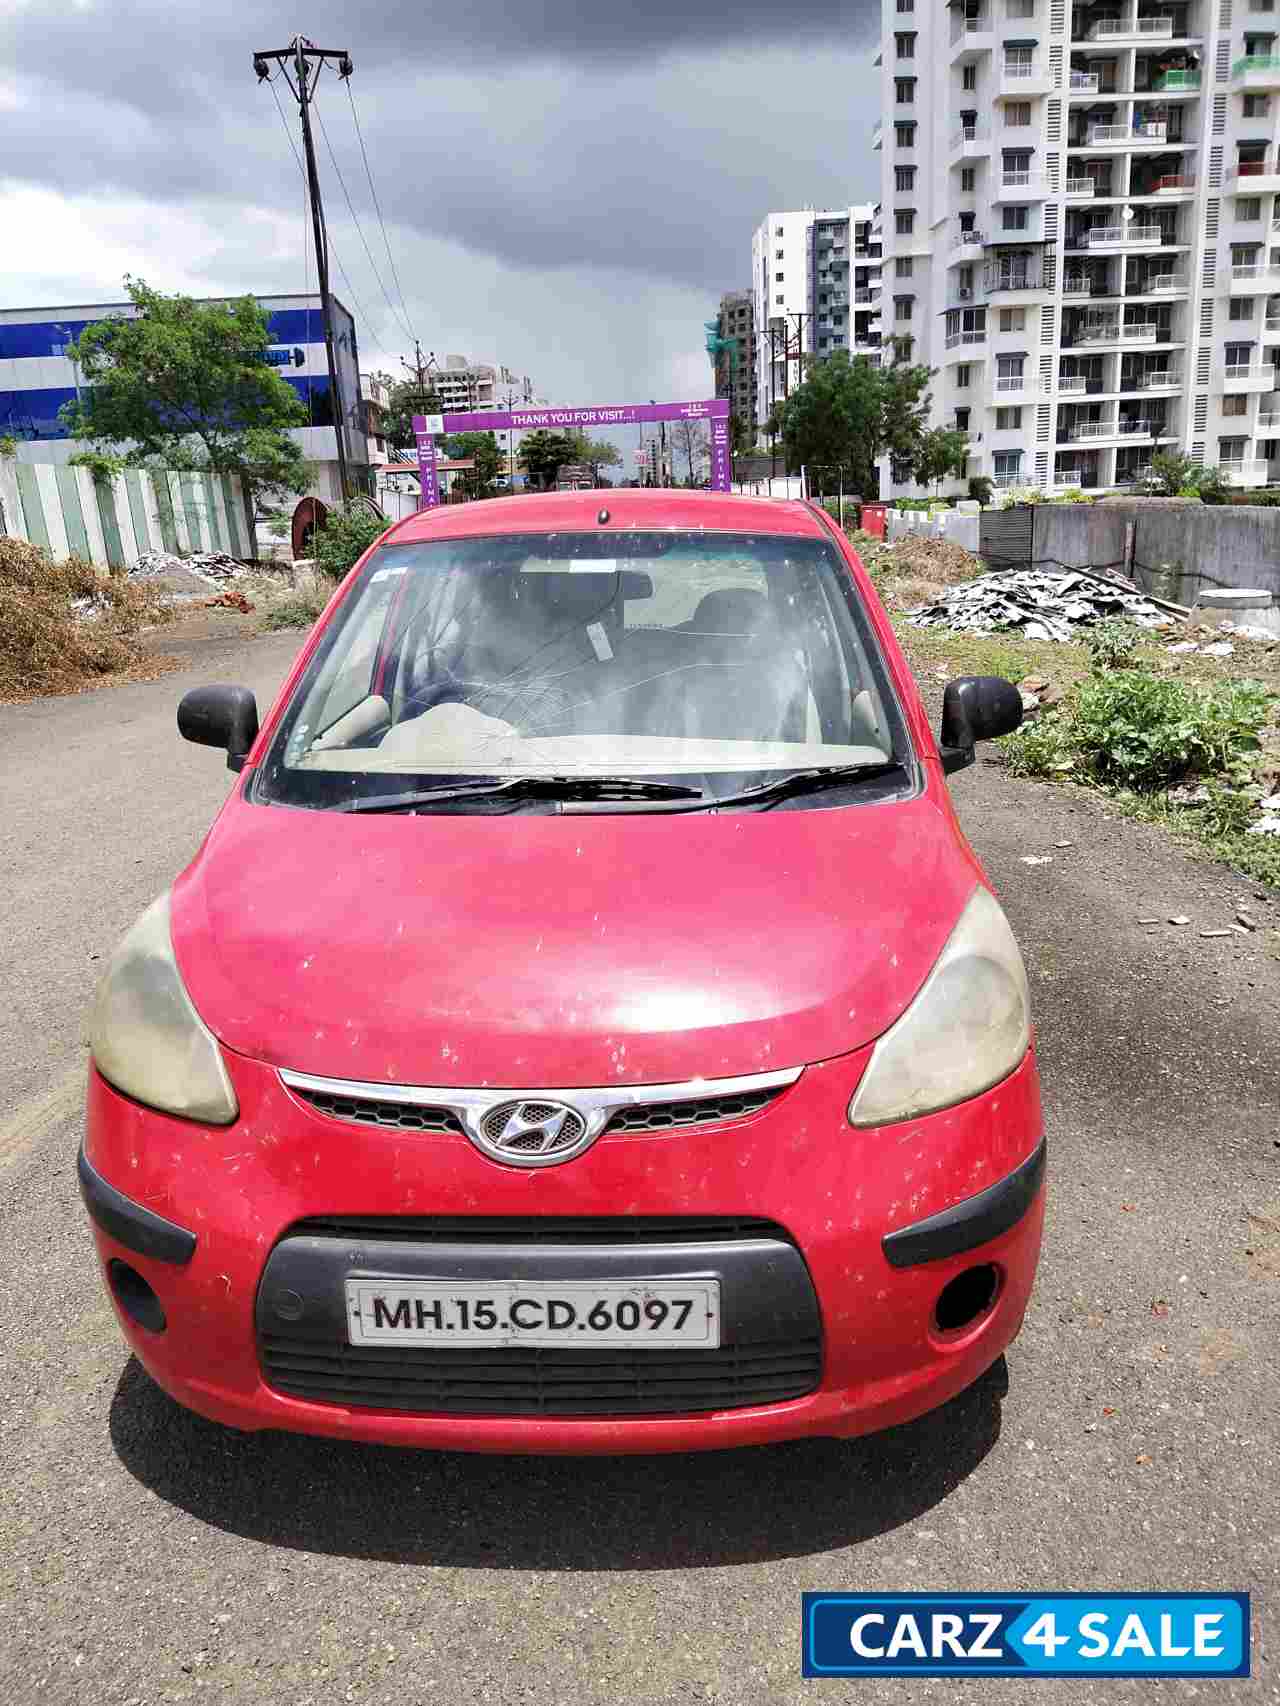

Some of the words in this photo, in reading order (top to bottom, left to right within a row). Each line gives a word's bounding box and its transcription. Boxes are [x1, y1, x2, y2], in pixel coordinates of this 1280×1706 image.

[511, 415, 549, 425] THANK
[550, 412, 573, 423] YOU
[574, 411, 597, 422] FOR
[373, 1298, 694, 1331] MH.15.CD.6097
